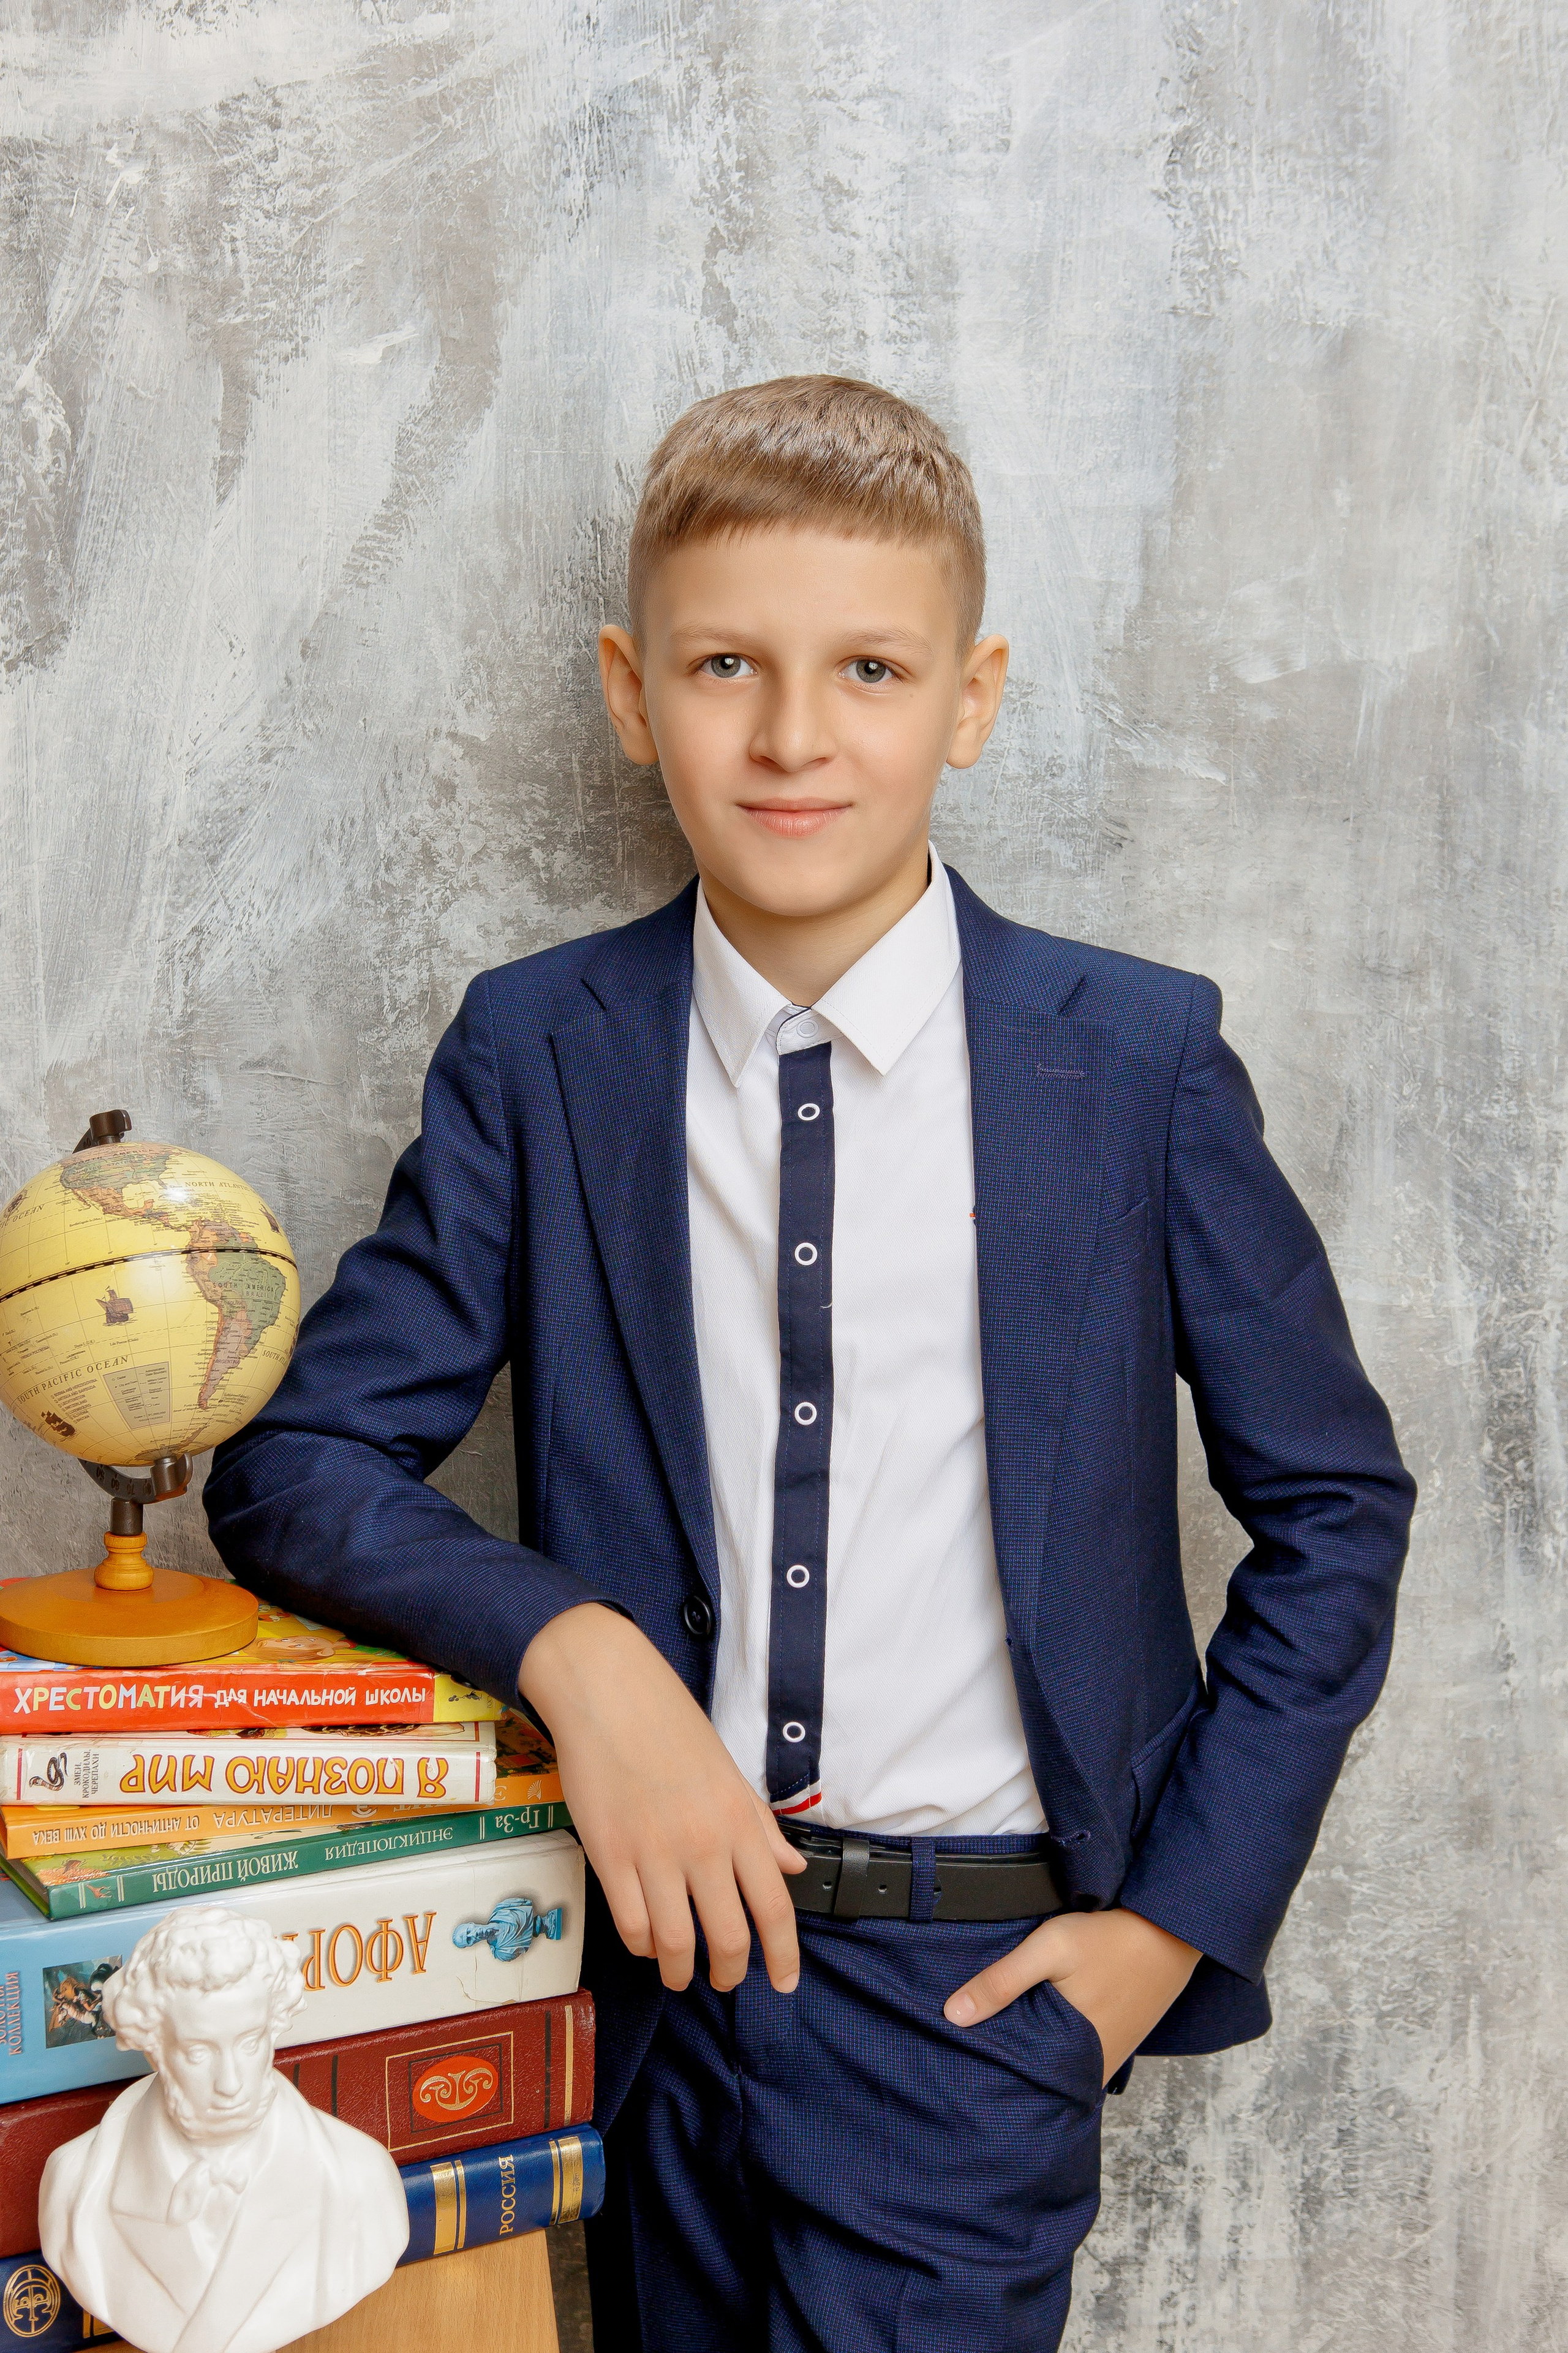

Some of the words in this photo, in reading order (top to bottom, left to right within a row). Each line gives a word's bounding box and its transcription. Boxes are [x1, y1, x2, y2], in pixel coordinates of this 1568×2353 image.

[12, 1203, 45, 1223] OCEAN
[246, 1283, 274, 1293] AMERICA
[262, 1350, 280, 1361] SOUTH
[17, 1386, 40, 1404] SOUTH
[41, 1369, 82, 1391] PACIFIC
[86, 1356, 129, 1373] OCEAN
[13, 1683, 204, 1714] ХРЕСТОМАТИЯ
[254, 1686, 356, 1707] НАЧАЛЬНОЙ
[365, 1687, 426, 1707] ШКОЛЫ
[119, 1754, 215, 1795] МИР
[225, 1756, 405, 1795] ПОЗНАЮ
[417, 1757, 449, 1798] Я
[91, 1822, 108, 1840] ДО
[110, 1816, 182, 1838] АНТИЧНОСТИ
[184, 1815, 200, 1831] ОТ
[213, 1804, 334, 1829] ЛИТЕРАТУРА
[494, 1806, 540, 1834] Гр-За
[32, 1828, 61, 1846] ВЕКА
[325, 1827, 454, 1861] ЭНЦИКЛОПЕДИЯ
[151, 1862, 233, 1893] ПРИРОДЫ
[237, 1851, 299, 1883] ЖИВОЙ
[274, 1911, 437, 1991] АФОР
[6, 1971, 22, 2056] КОЛЛЕКЦИЯ
[498, 2154, 516, 2236] РОССИЯ
